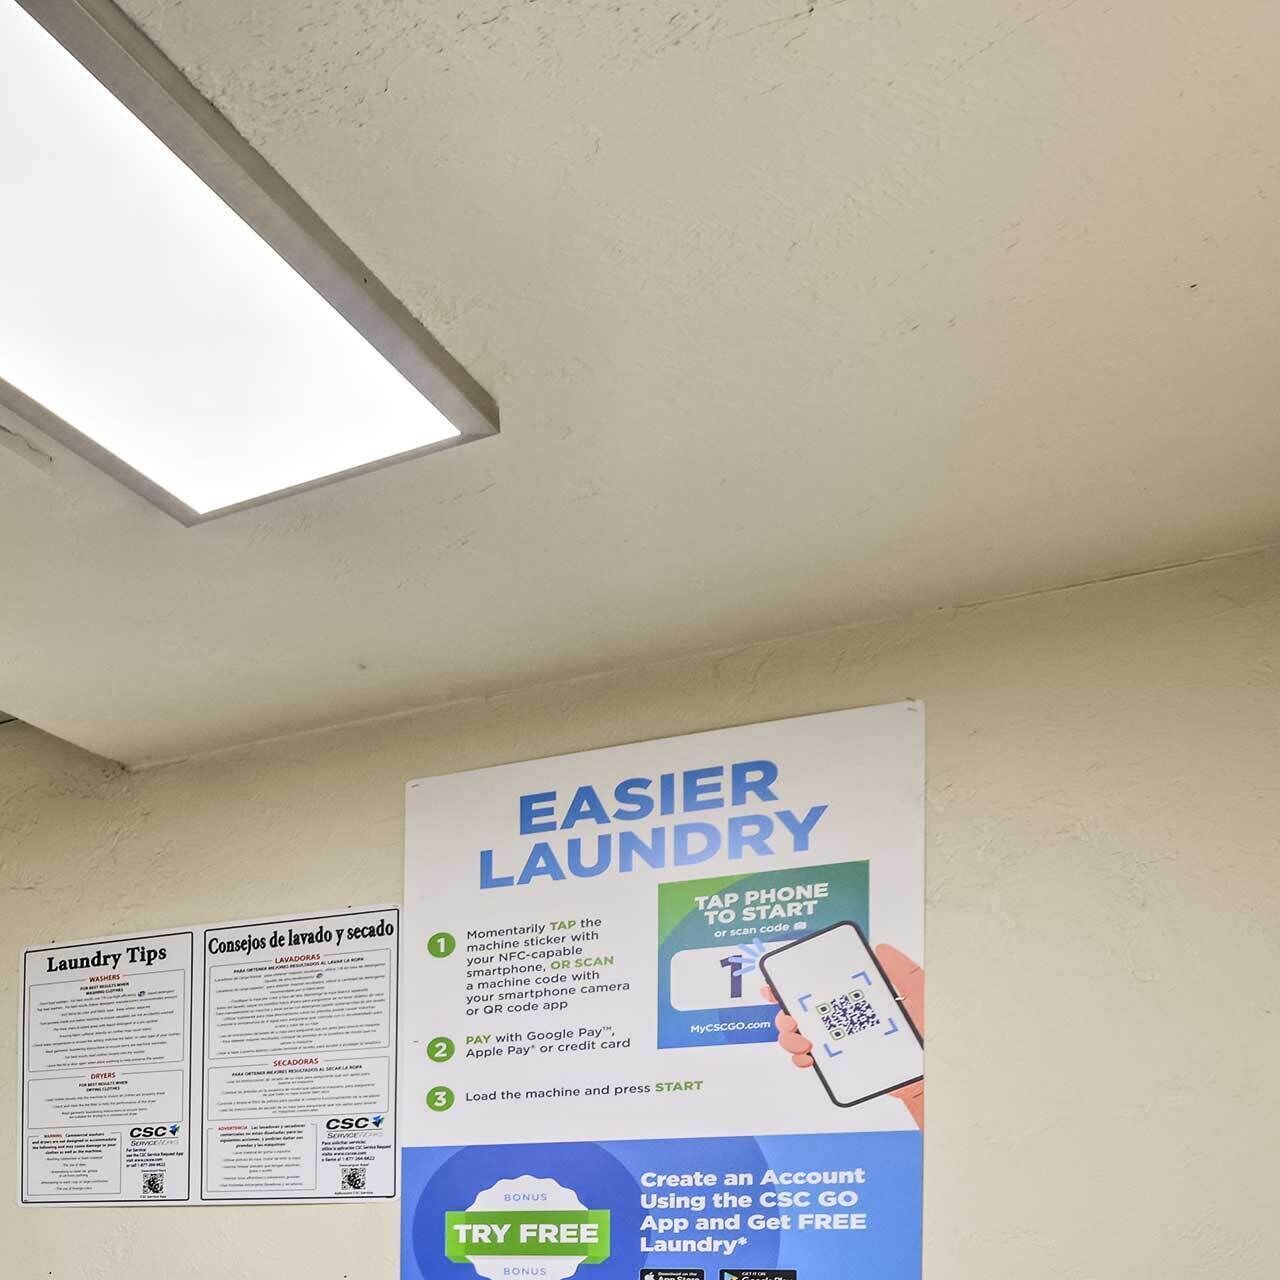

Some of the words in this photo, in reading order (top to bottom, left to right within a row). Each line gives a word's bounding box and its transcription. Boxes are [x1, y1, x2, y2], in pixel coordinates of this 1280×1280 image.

[520, 760, 778, 835] EASIER
[480, 805, 828, 889] LAUNDRY
[695, 893, 738, 910] TAP
[745, 883, 828, 905] PHONE
[704, 909, 736, 925] TO
[742, 900, 817, 921] START
[208, 935, 266, 955] Consejos
[269, 931, 285, 948] de
[288, 926, 332, 946] lavado
[336, 929, 344, 946] y
[347, 919, 394, 940] secado
[467, 924, 545, 939] Momentarily
[550, 920, 576, 931] TAP
[580, 918, 602, 927] the
[715, 929, 726, 937] or
[730, 928, 756, 936] scan
[760, 923, 789, 933] code
[437, 938, 444, 953] 1
[467, 938, 519, 952] machine
[524, 935, 566, 947] sticker
[571, 931, 598, 942] with
[47, 951, 122, 972] Laundry
[127, 946, 167, 965] Tips
[275, 954, 321, 964] LAVADORAS
[467, 955, 494, 966] your
[499, 947, 582, 962] NFC-capable
[466, 964, 545, 978] smartphone,
[551, 961, 570, 970] OR
[575, 956, 614, 968] SCAN
[720, 955, 742, 998] 1
[89, 974, 120, 982] WASHERS
[478, 977, 530, 989] machine
[535, 974, 567, 984] code
[572, 971, 599, 981] with
[466, 994, 494, 1005] your
[498, 986, 576, 1001] smartphone
[581, 982, 630, 993] camera
[466, 1007, 478, 1015] or
[484, 1005, 503, 1014] QR
[507, 1002, 538, 1012] code
[543, 1000, 568, 1011] app
[691, 1021, 770, 1033] MyCSCGO.com
[466, 1035, 490, 1045] PAY
[496, 1032, 522, 1043] with
[527, 1029, 574, 1042] Google
[435, 1043, 447, 1057] 2
[466, 1046, 503, 1059] Apple
[540, 1044, 554, 1053] or
[558, 1040, 596, 1051] credit
[600, 1039, 630, 1049] card
[273, 1058, 319, 1067] SECADORAS
[434, 1091, 447, 1106] 3
[466, 1091, 496, 1101] Load
[501, 1090, 521, 1100] the
[525, 1087, 580, 1098] machine
[585, 1085, 609, 1095] and
[615, 1084, 650, 1095] press
[655, 1081, 703, 1092] START
[130, 1127, 167, 1138] CSC
[326, 1118, 369, 1129] CSC
[640, 1171, 717, 1187] Create
[724, 1172, 753, 1186] an
[760, 1168, 866, 1185] Account
[640, 1192, 706, 1211] Using
[712, 1192, 752, 1208] the
[759, 1191, 810, 1208] CSC
[818, 1190, 858, 1207] GO
[640, 1215, 689, 1233] App
[695, 1214, 740, 1230] and
[747, 1215, 791, 1230] Get
[798, 1214, 867, 1230] FREE
[453, 1224, 511, 1243] TRY
[520, 1224, 599, 1243] FREE
